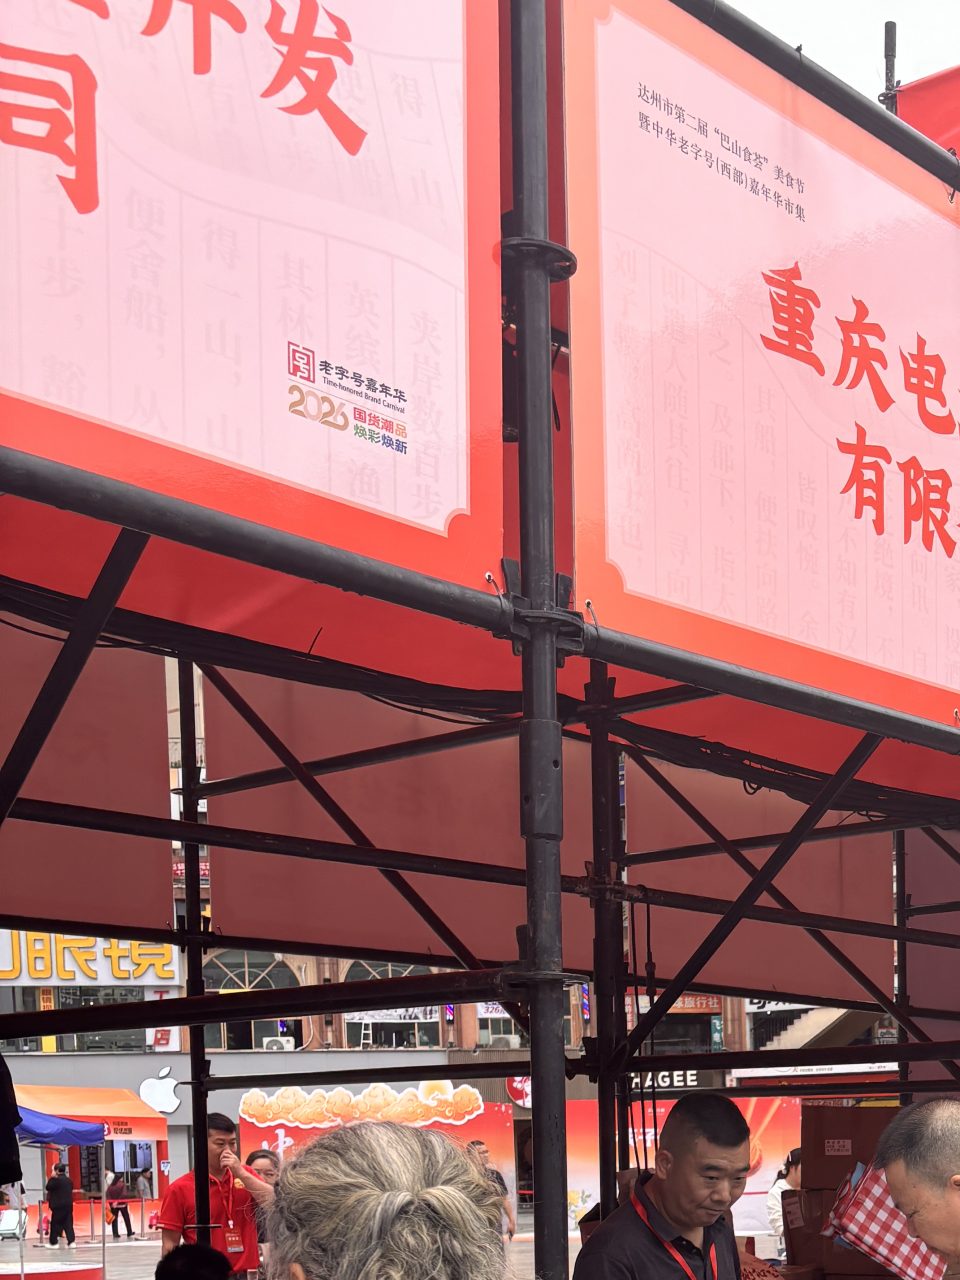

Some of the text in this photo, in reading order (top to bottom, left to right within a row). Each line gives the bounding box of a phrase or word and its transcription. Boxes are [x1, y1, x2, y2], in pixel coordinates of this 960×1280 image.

[319, 360, 407, 403] 老字号嘉年华
[323, 376, 405, 414] Time-honored Brand Carnival
[288, 384, 349, 431] 2026
[353, 406, 407, 439] 国货潮品
[353, 423, 407, 455] 焕彩焕新
[0, 930, 175, 980] 眼镜
